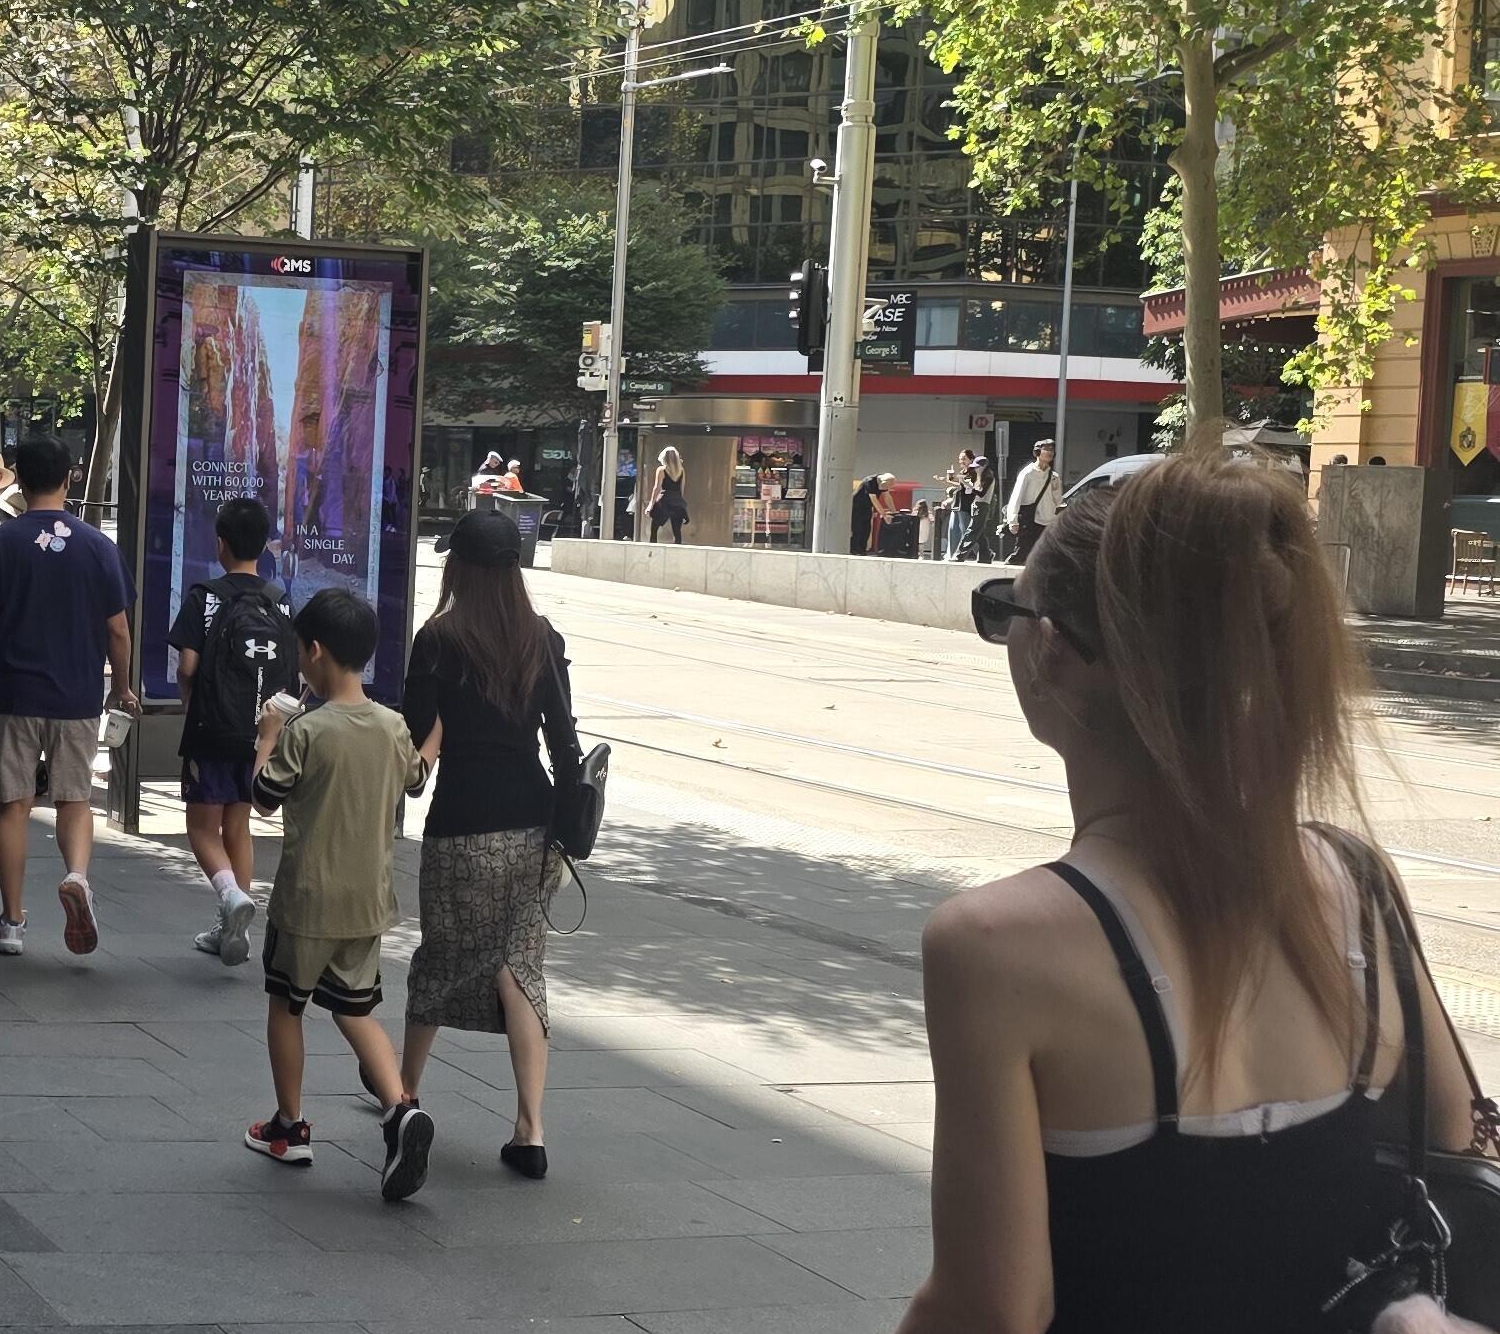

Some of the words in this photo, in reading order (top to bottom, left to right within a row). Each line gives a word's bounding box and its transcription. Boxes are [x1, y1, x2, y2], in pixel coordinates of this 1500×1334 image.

[865, 346, 889, 357] George
[891, 345, 898, 354] St
[192, 461, 249, 473] CONNECT
[192, 475, 222, 487] WITH
[224, 476, 264, 488] 60,000
[203, 490, 238, 501] YEARS
[296, 524, 308, 535] IN
[309, 525, 319, 535] A
[303, 539, 345, 550] SINGLE
